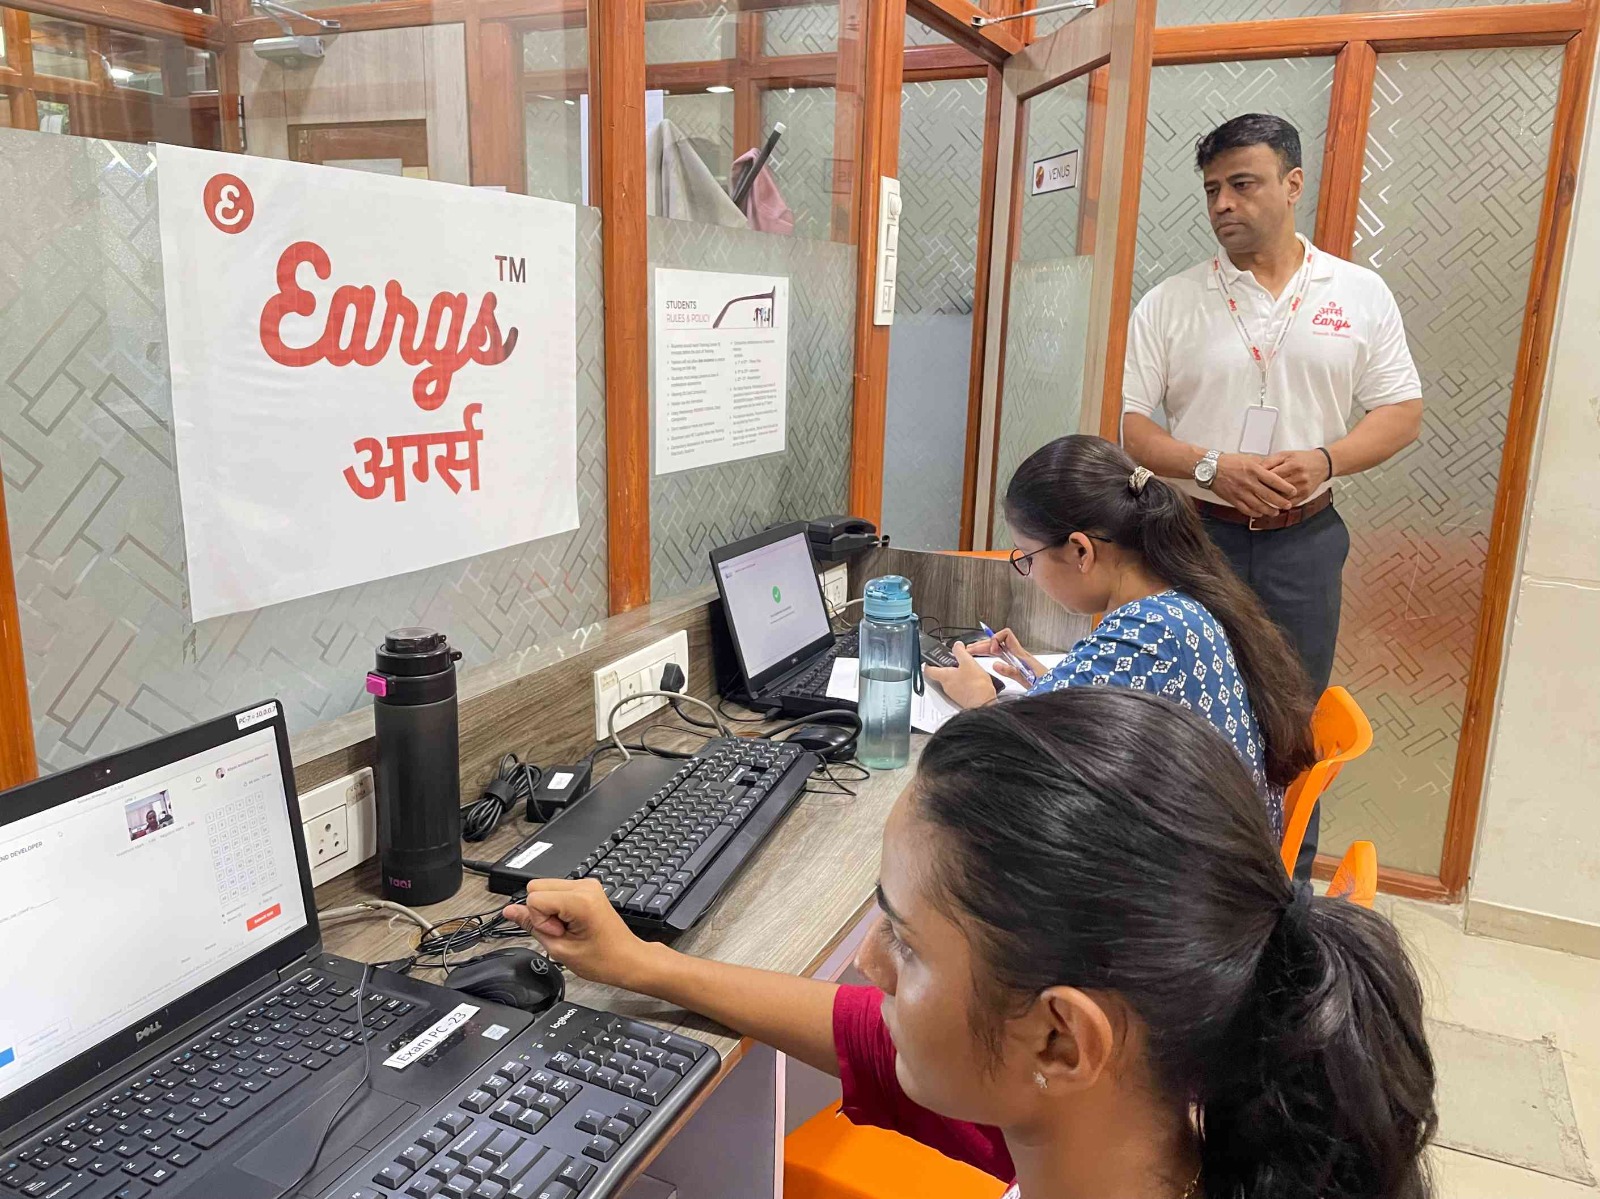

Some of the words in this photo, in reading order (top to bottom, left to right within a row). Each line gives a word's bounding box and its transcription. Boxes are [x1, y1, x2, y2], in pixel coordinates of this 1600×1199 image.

[1048, 165, 1071, 181] VENUS
[494, 255, 527, 284] TM
[666, 300, 697, 310] STUDENTS
[259, 240, 519, 411] Eargs
[666, 313, 686, 323] RULES
[691, 313, 710, 322] POLICY
[1312, 313, 1352, 332] Eargs
[342, 402, 484, 503] अर्ग्स
[10, 841, 43, 859] DEVELOPER
[550, 1007, 578, 1029] logitech
[135, 1021, 162, 1042] DELL
[396, 1038, 433, 1062] Exam
